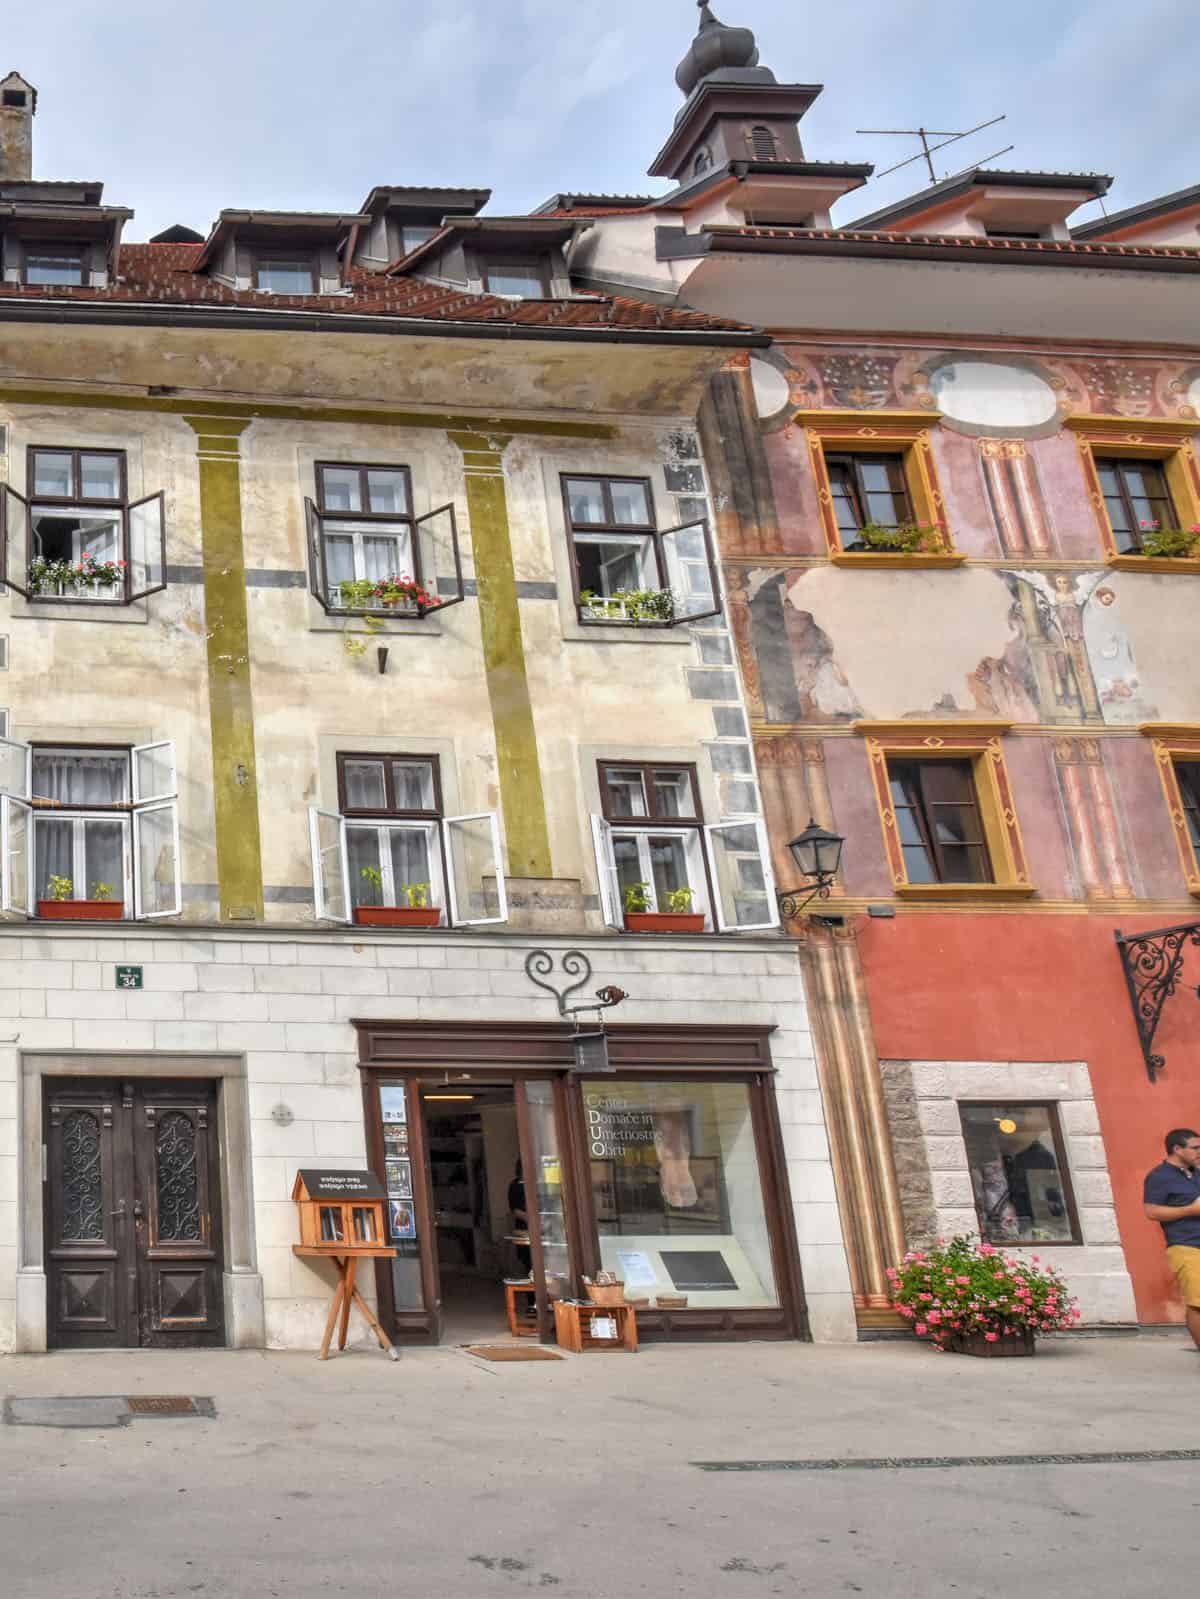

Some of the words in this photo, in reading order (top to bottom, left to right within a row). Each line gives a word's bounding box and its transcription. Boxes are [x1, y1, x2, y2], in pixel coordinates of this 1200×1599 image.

[123, 977, 136, 987] 34
[588, 1110, 640, 1124] Domače
[642, 1111, 654, 1124] in
